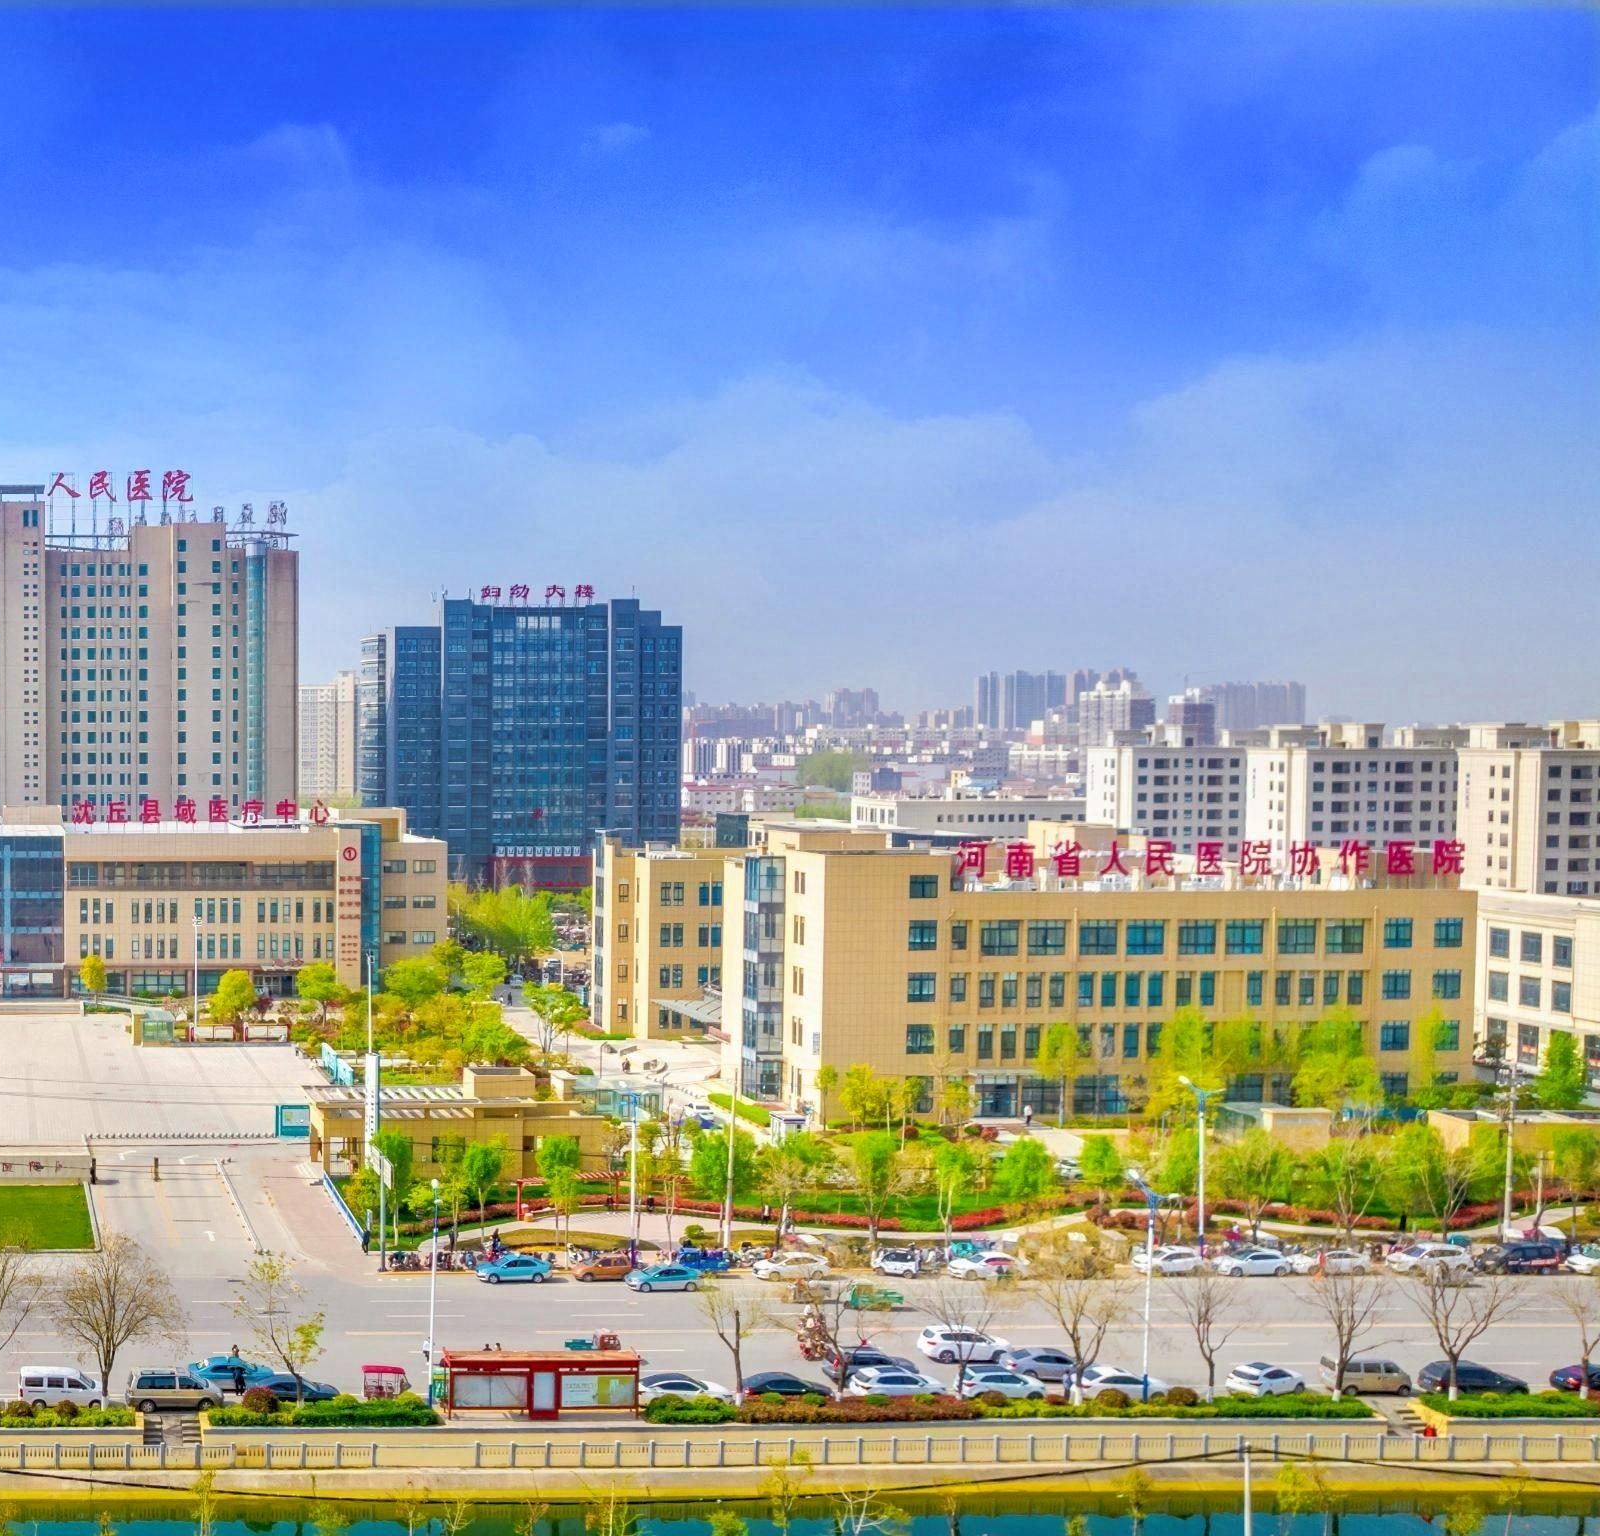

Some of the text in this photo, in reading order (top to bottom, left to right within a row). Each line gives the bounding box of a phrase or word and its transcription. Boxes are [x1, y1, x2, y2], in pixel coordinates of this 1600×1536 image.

[481, 584, 595, 598] 妇幼大楼
[72, 799, 330, 825] 沈丘县域医疗中心
[956, 839, 1465, 878] 河南省人民医院协作医院
